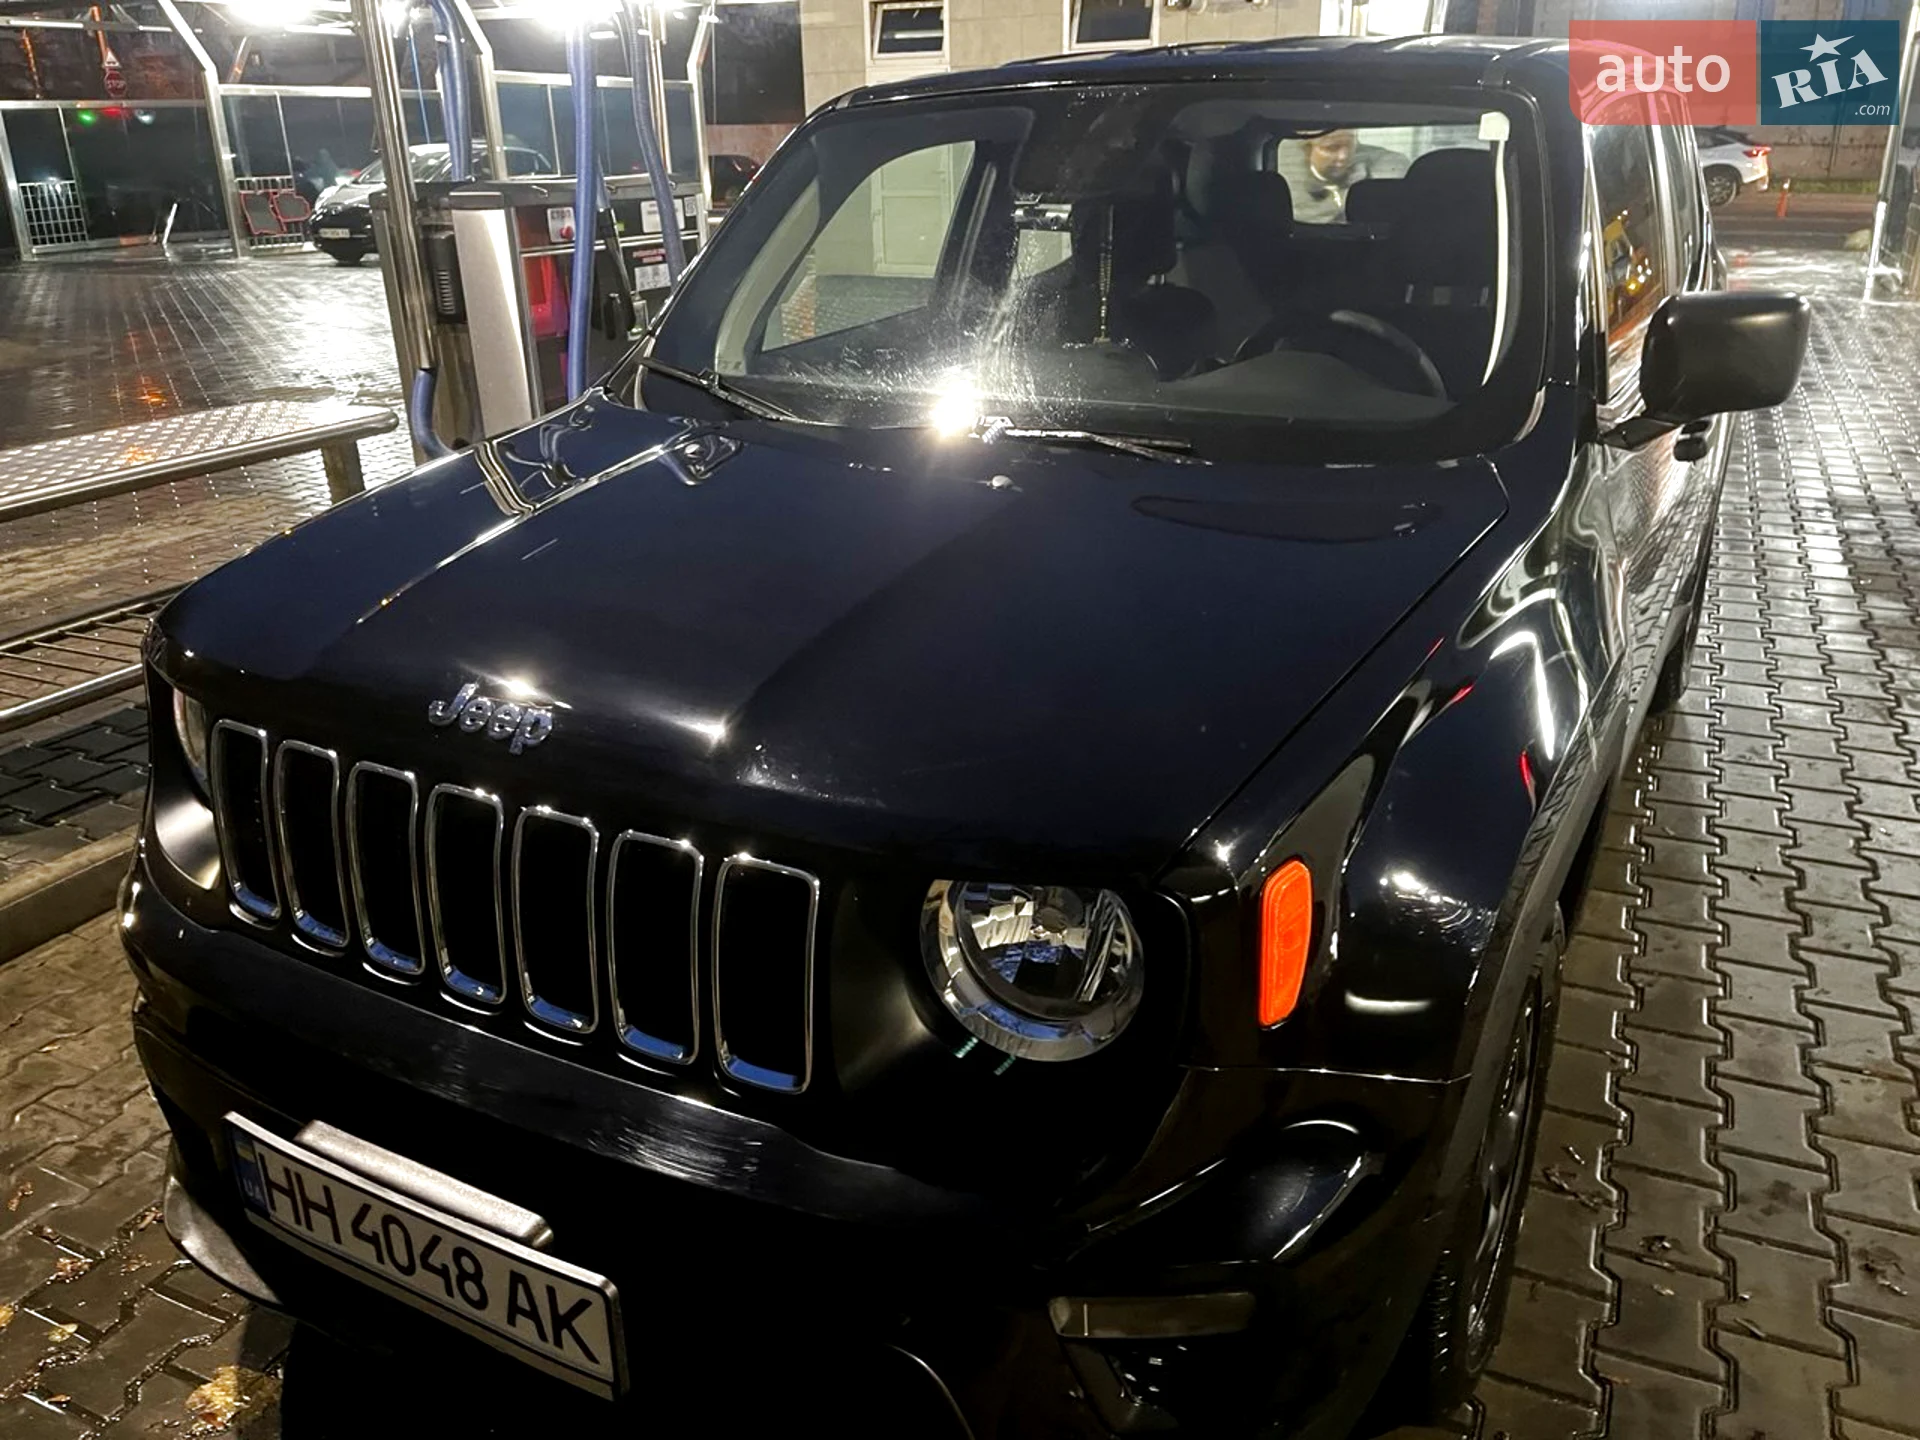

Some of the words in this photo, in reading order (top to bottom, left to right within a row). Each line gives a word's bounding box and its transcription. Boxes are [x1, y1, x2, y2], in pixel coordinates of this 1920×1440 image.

[428, 683, 553, 756] Jeep
[258, 1152, 343, 1245] HH
[351, 1204, 489, 1312] 4048
[506, 1269, 600, 1364] AK
